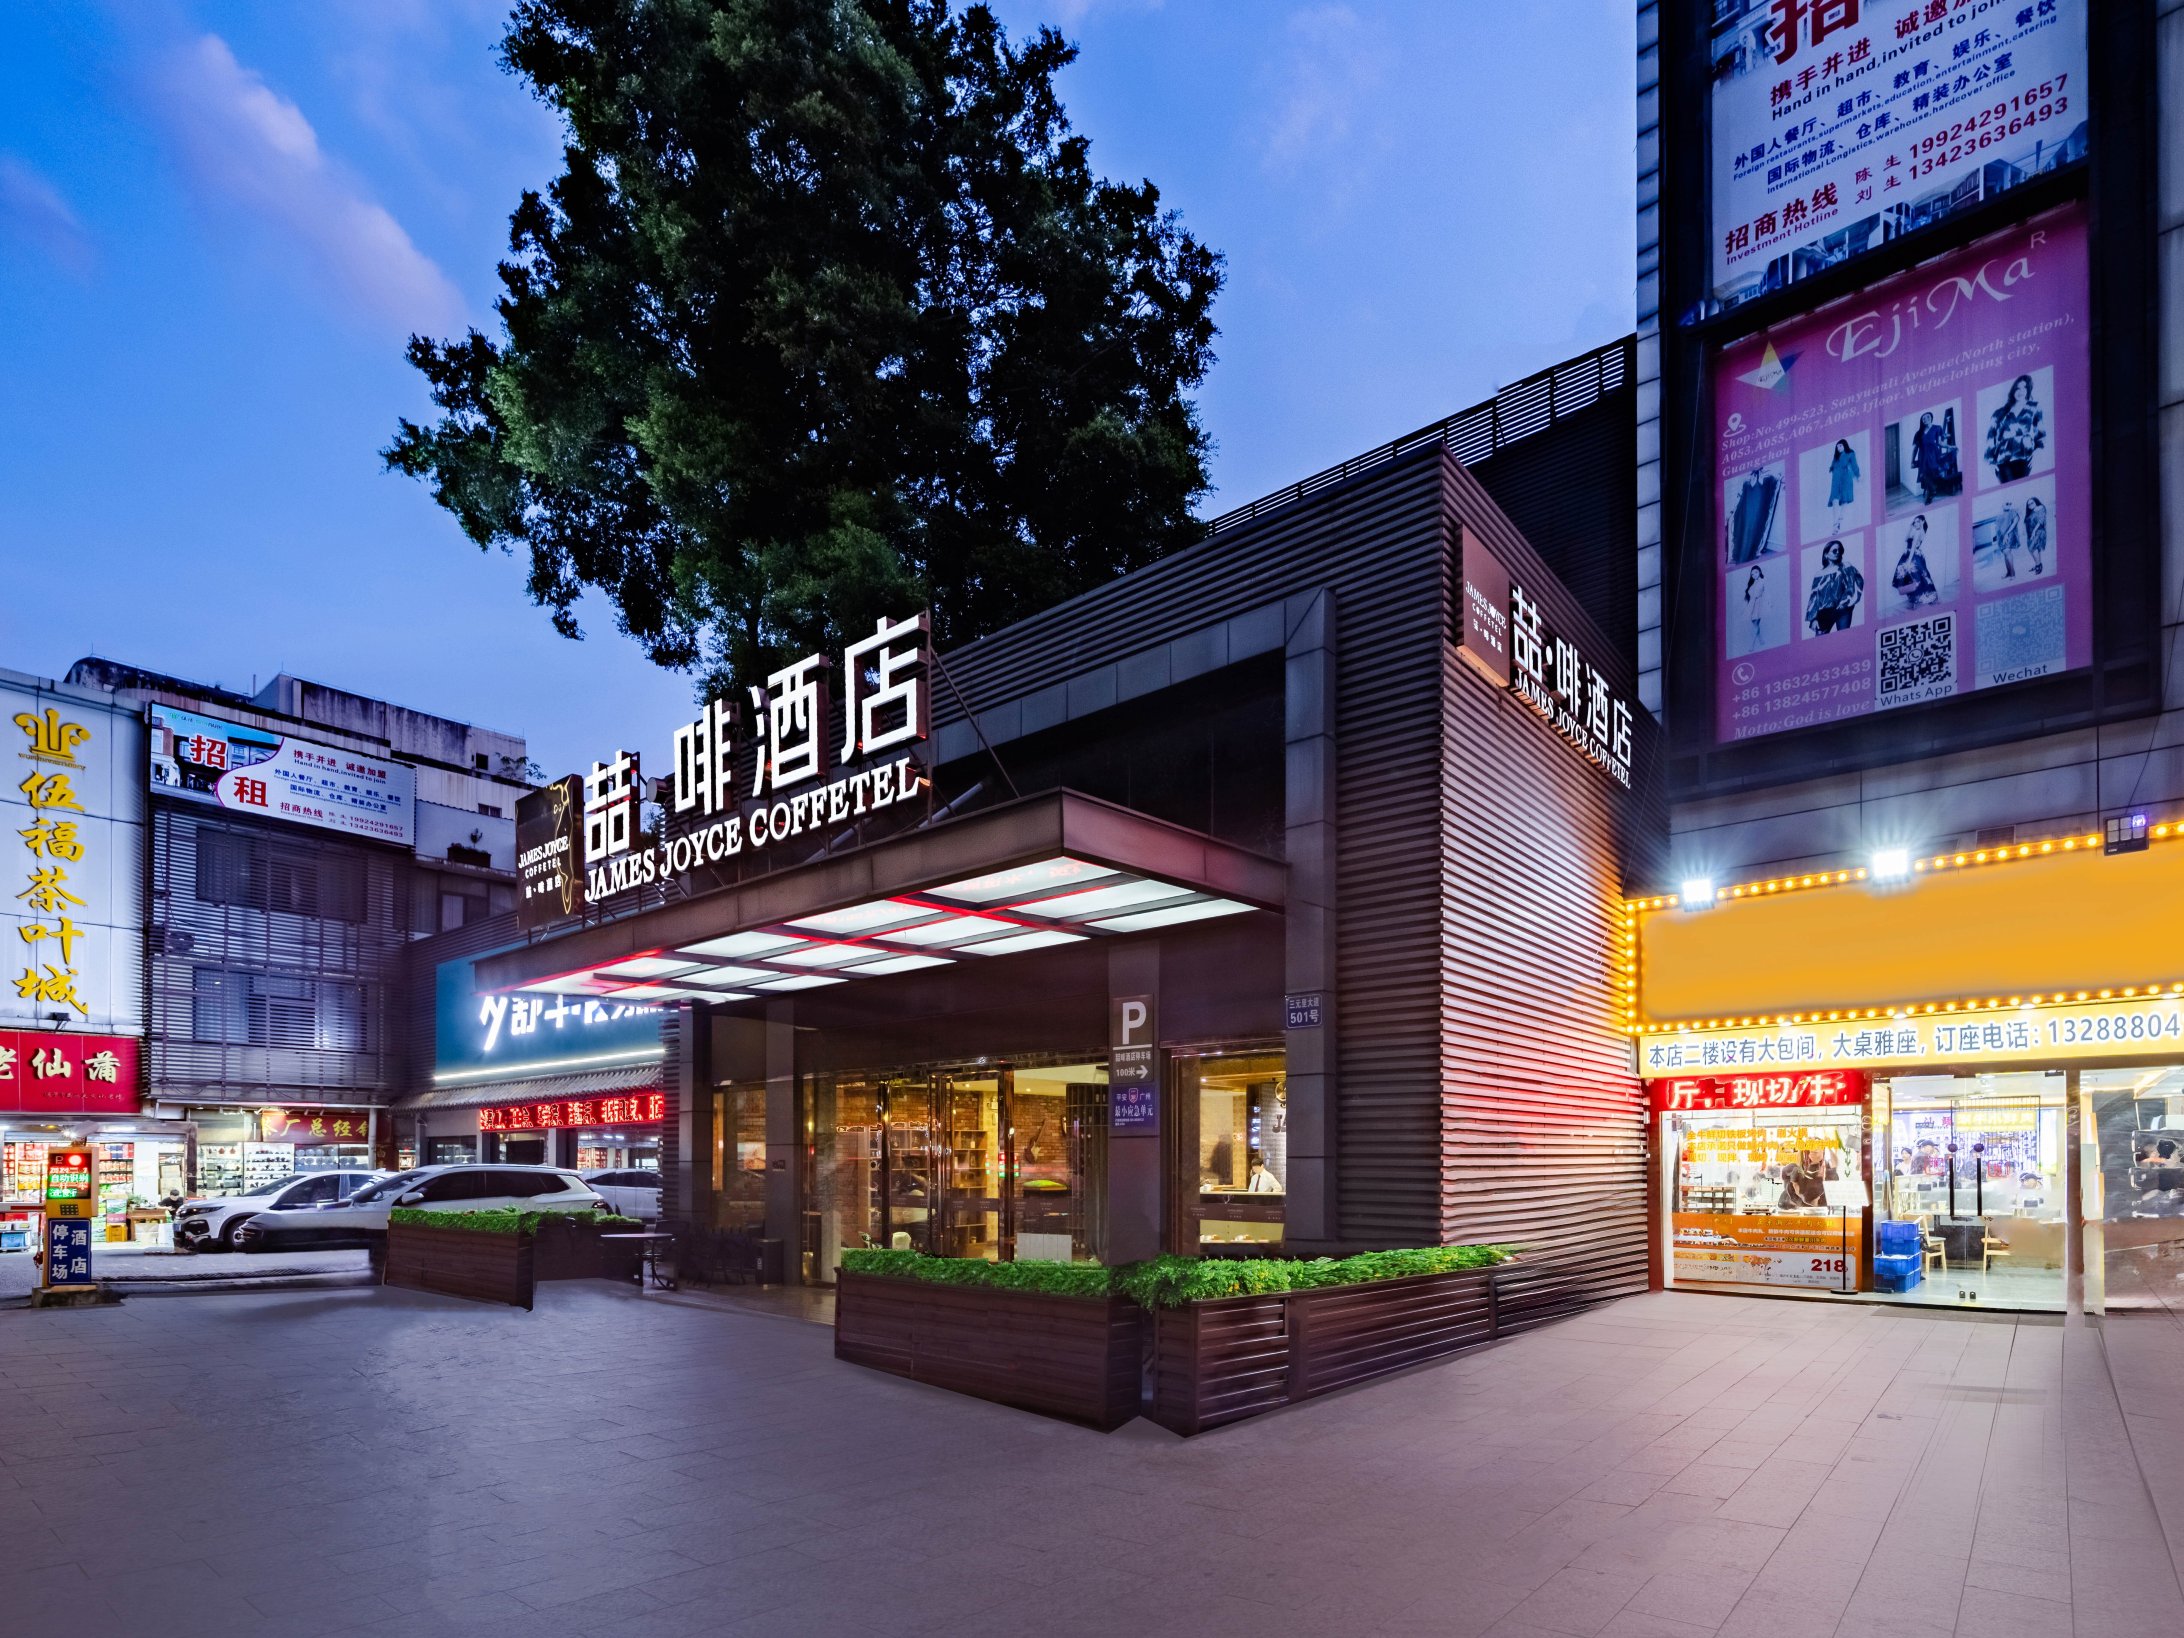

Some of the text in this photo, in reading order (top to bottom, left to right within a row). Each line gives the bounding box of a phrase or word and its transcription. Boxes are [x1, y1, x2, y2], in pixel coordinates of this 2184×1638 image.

[1770, 37, 1870, 107] 携手并进
[1772, 91, 1812, 121] Hand
[1816, 84, 1831, 99] in
[1948, 14, 1966, 29] to
[1767, 161, 1824, 194] International
[1986, 69, 2016, 88] office
[1909, 73, 2068, 159] 19924291657
[1909, 96, 2068, 181] 13423636493
[1733, 159, 1765, 182] Foreign
[1725, 182, 1838, 255] 招商热线
[1727, 208, 1839, 266] Investment Hotline
[2030, 230, 2046, 248] R
[1722, 447, 1790, 477] Guangzhou
[1732, 659, 1871, 702] +86 13632433439
[1880, 684, 1952, 707] Whats App
[1993, 664, 2048, 684] Wechat
[1732, 677, 1871, 720] +86 13824577408
[1819, 708, 1831, 720] is
[1837, 700, 1870, 716] love
[1515, 668, 1631, 789] JAMES JOYCE COFFETEL
[190, 735, 227, 769] 招
[233, 776, 268, 807] 租
[584, 757, 920, 903] JAMES JOYCE COFFETEL
[518, 836, 569, 869] JAMES JOYCE
[525, 857, 561, 879] COFFETEL
[1122, 1001, 1147, 1045] P
[1290, 1010, 1320, 1024] 501号
[1116, 1067, 1136, 1077] 100米
[52, 1224, 69, 1280] 停车场
[70, 1229, 87, 1274] 酒店
[1811, 1259, 1844, 1273] 218
